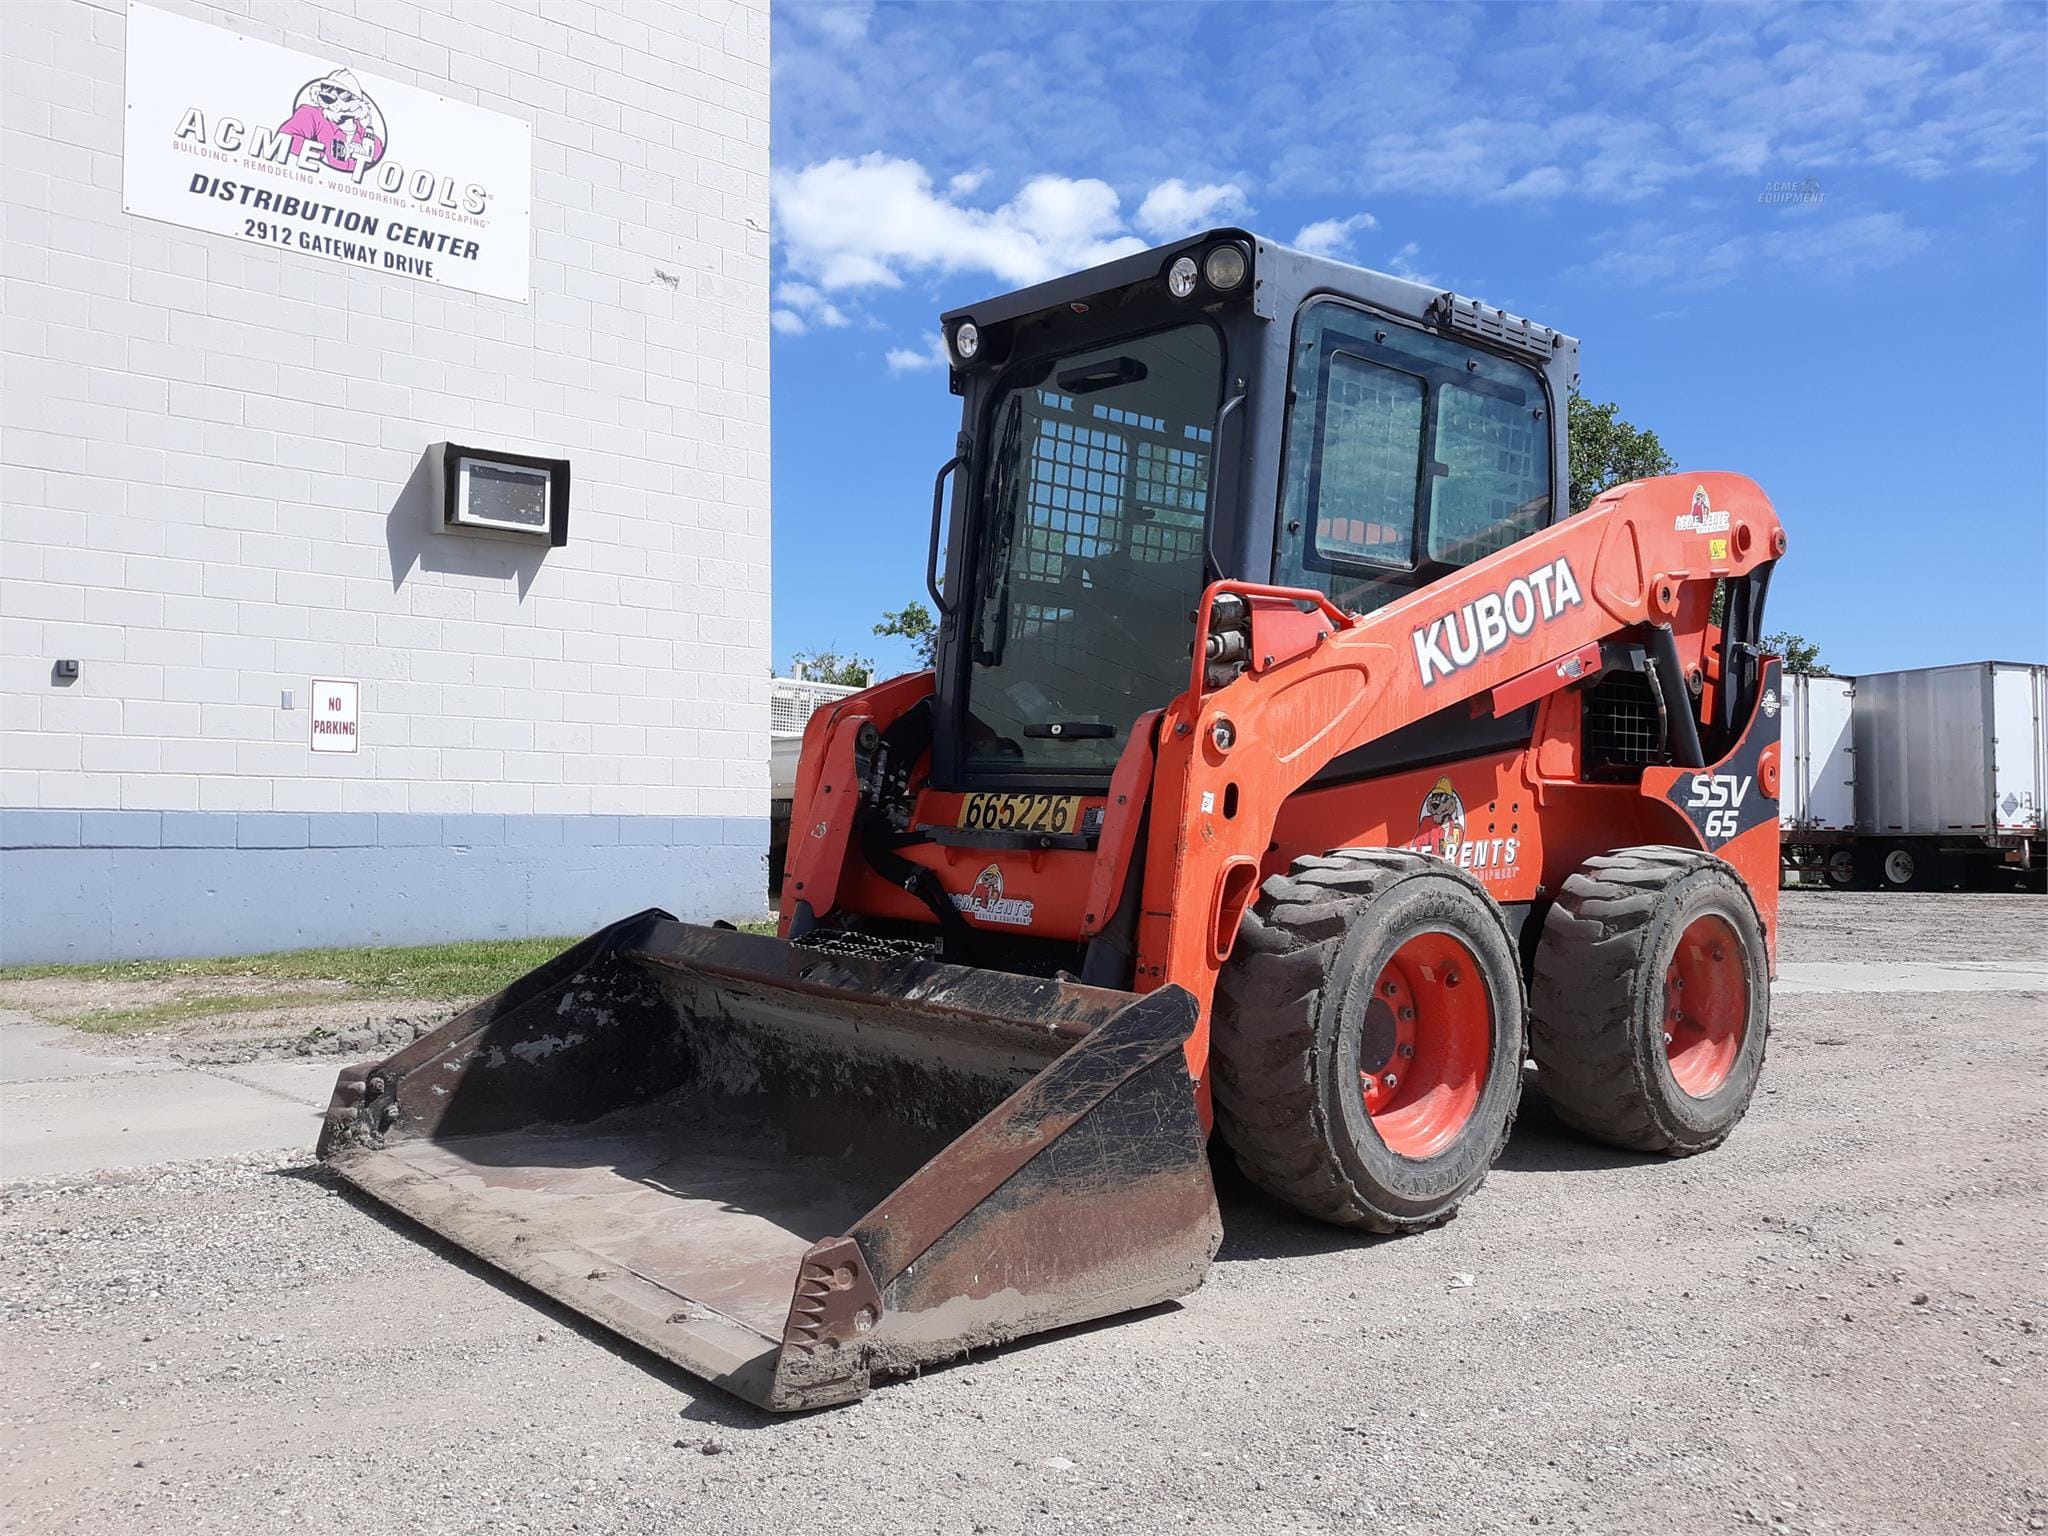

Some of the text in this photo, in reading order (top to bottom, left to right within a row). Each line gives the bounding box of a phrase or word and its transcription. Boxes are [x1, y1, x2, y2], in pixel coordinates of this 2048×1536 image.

[174, 107, 487, 215] ACME TOOLS
[173, 141, 486, 229] BUILDING REMODELING WOODWORKING LANDSCAPING
[189, 172, 480, 261] DISTRIBUTION CENTER
[245, 218, 433, 278] 2912 GATEWAY DRIVE
[1413, 557, 1582, 687] KUBOTA
[328, 697, 342, 711] NO
[313, 720, 355, 735] PARKING
[1687, 774, 1752, 807] SSV
[966, 793, 1070, 832] 665226
[1705, 810, 1739, 837] 65
[1444, 838, 1517, 868] RENTS
[987, 898, 1031, 917] RENTS
